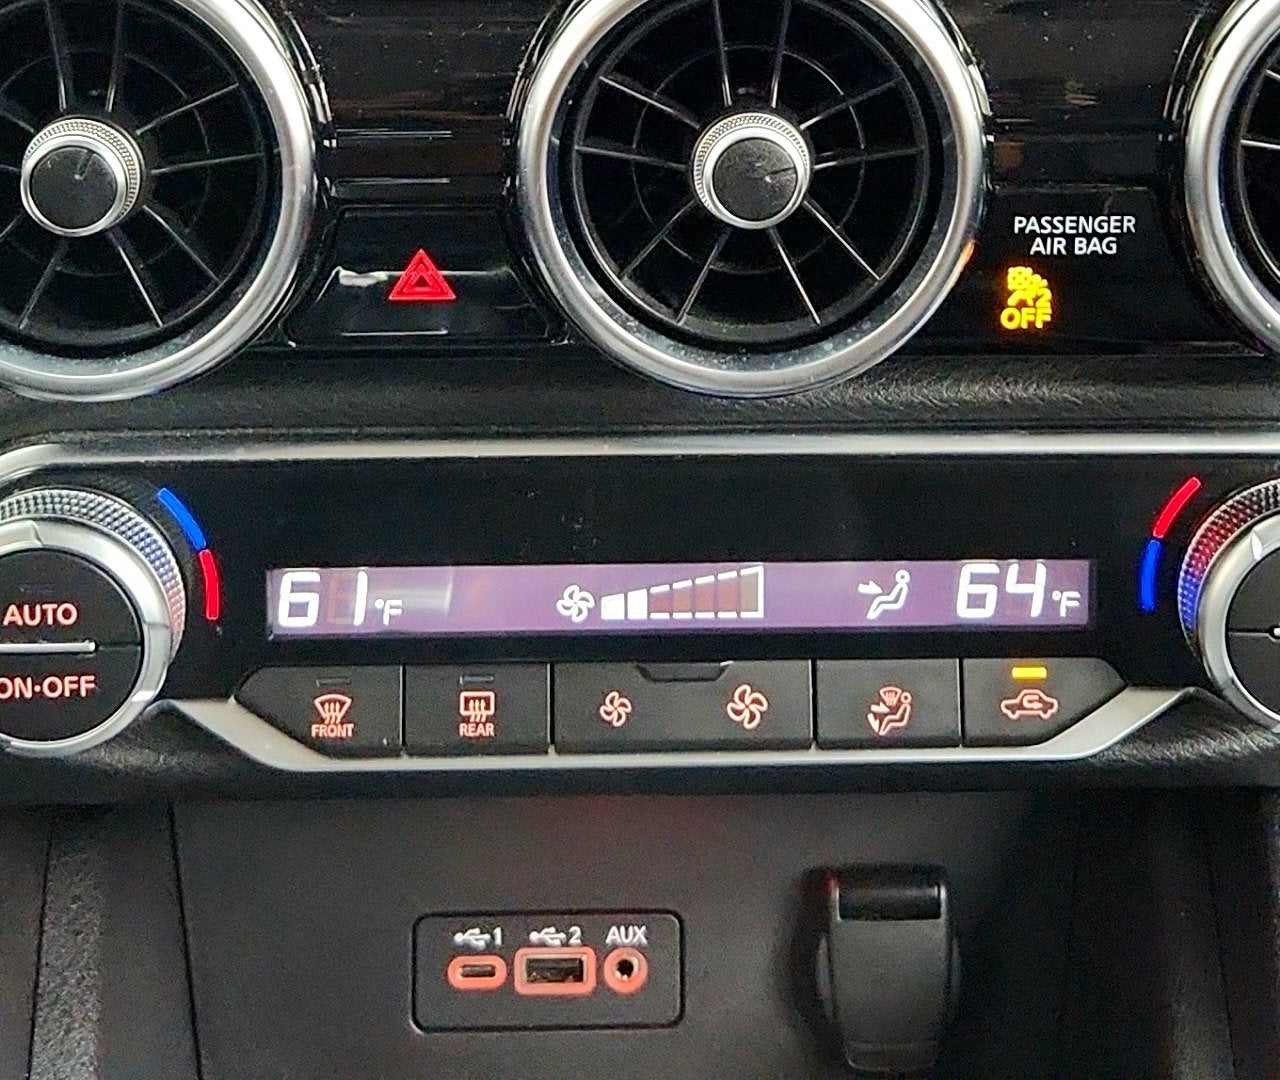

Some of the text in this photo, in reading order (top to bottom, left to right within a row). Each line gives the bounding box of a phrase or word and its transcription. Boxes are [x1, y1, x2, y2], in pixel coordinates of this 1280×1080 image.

[1013, 215, 1136, 234] PASSENGER
[1029, 236, 1117, 255] AIR BAG
[1000, 307, 1053, 330] OFF
[2, 602, 78, 627] AUTO
[311, 723, 355, 738] FRONT
[459, 722, 495, 737] REAR
[493, 927, 503, 946] 1
[569, 926, 582, 944] 2
[605, 925, 648, 946] AUX
